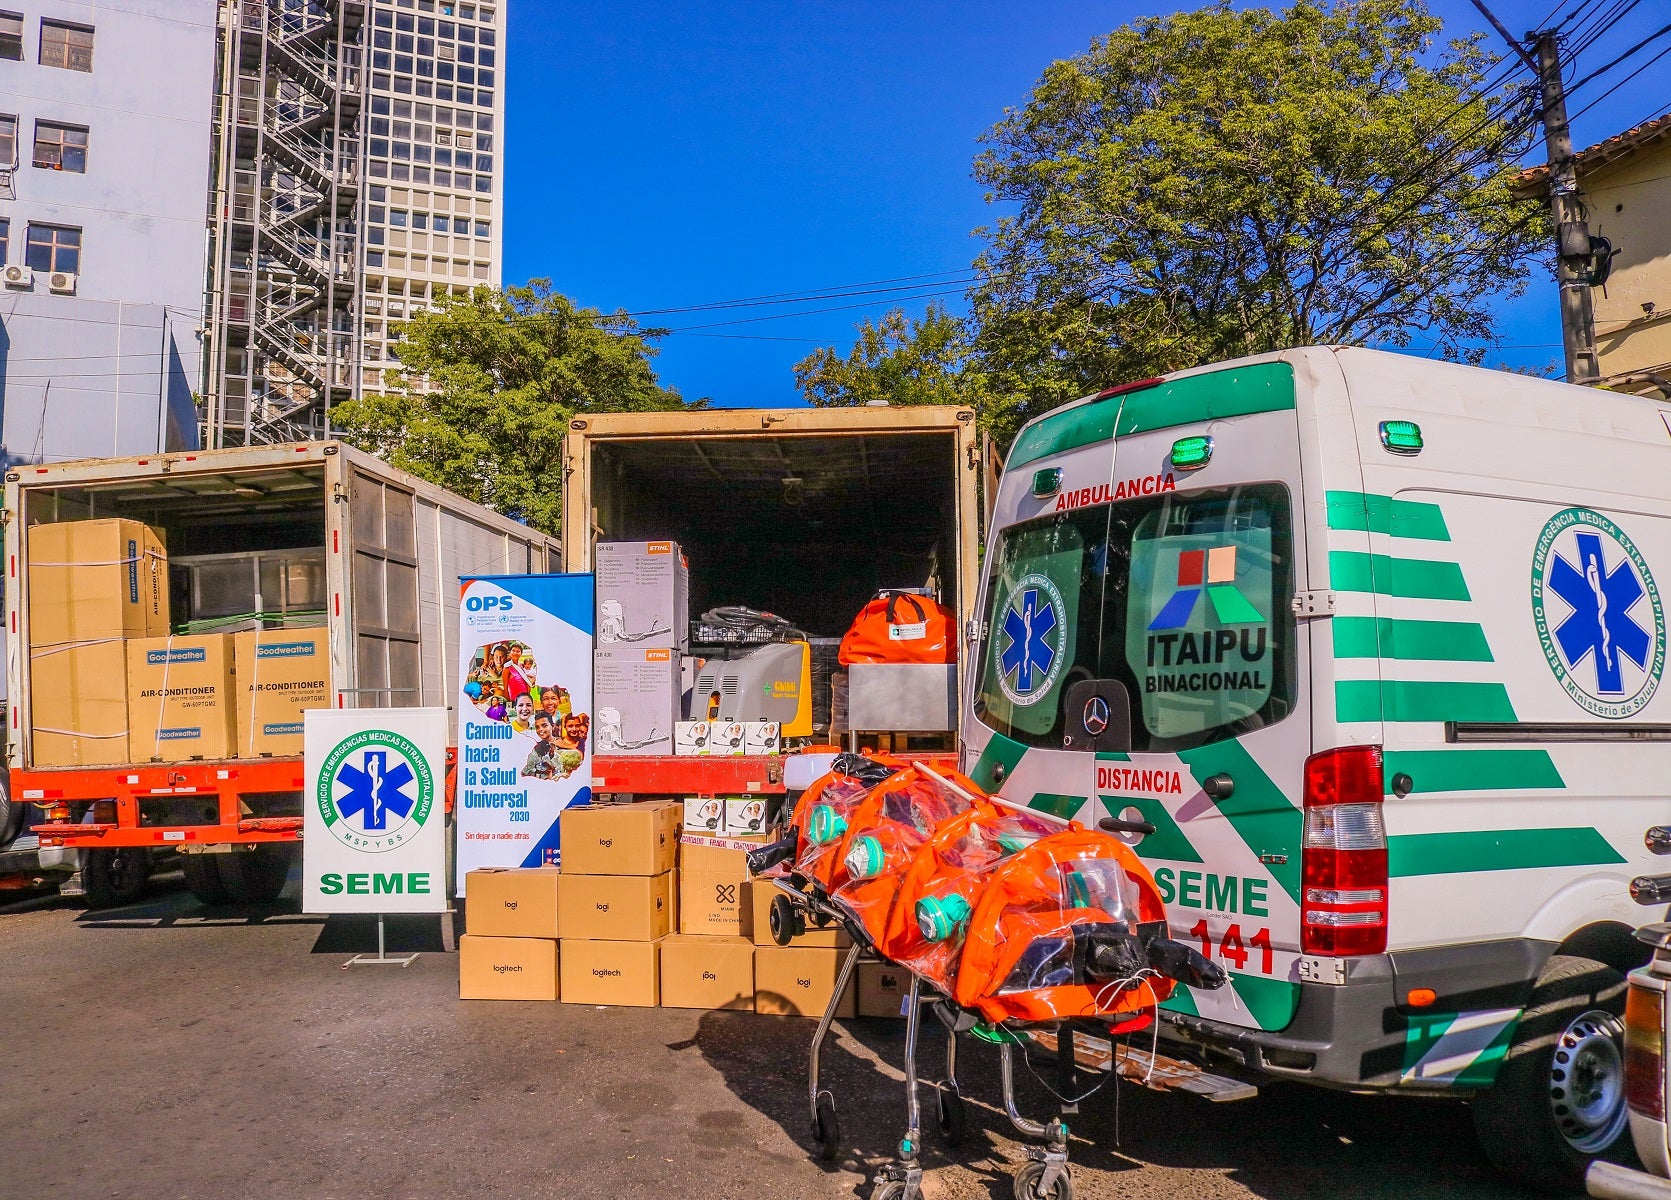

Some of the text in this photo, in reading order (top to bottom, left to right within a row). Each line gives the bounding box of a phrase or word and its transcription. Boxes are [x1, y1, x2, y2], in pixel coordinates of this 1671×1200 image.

[1055, 472, 1176, 511] AMBULANCIA
[1578, 512, 1616, 536] MEDICA
[1533, 578, 1542, 598] DE
[466, 596, 514, 612] OPS
[1619, 535, 1665, 676] EXTRAHOSPITALARIA
[1147, 627, 1266, 667] ITAIPU
[1535, 606, 1564, 676] SERVICIO
[258, 646, 312, 655] Goodweather
[1145, 671, 1266, 693] BINACIONAL
[140, 686, 215, 697] AIR-CONDITIONER
[1566, 680, 1656, 716] Ministerio de Salud
[465, 722, 512, 740] Camino
[465, 744, 500, 762] hacia
[320, 732, 431, 818] SERVICIO DE EMERGENCIAS MEDICAS EXTRAHOSPITALARIAS
[465, 767, 516, 786] la Salud
[1097, 768, 1182, 794] DISTANCIA
[465, 790, 528, 808] Universal
[510, 811, 530, 822] 2030
[476, 832, 490, 841] dejar
[600, 839, 612, 847] logi
[320, 872, 430, 895] SEME
[1154, 868, 1268, 918] SEME
[504, 901, 518, 910] logi
[596, 903, 609, 912] logi
[1190, 919, 1272, 975] 141
[493, 965, 522, 974] logitech
[592, 969, 621, 978] logitech
[702, 971, 716, 980] logi
[797, 978, 810, 988] logi
